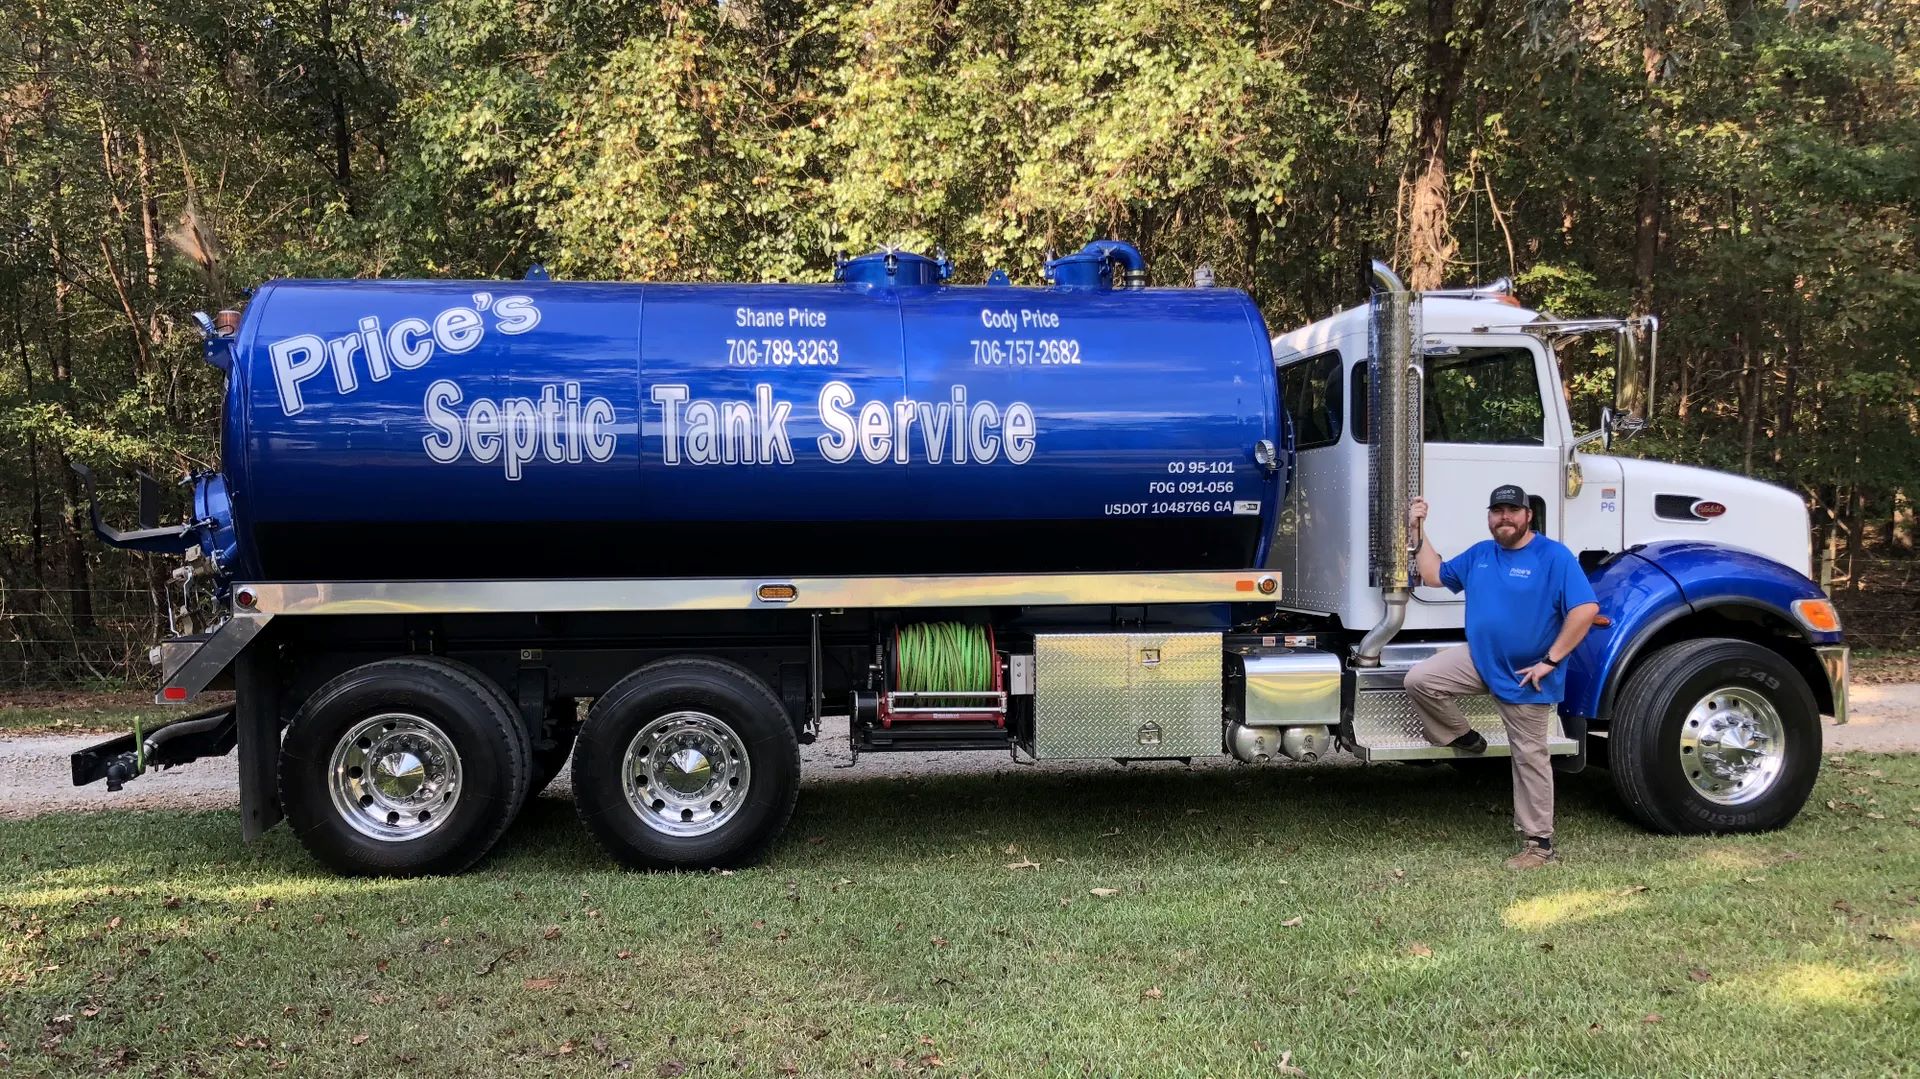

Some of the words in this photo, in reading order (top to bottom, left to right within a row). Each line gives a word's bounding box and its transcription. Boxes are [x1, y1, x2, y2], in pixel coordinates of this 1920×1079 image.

[735, 307, 785, 328] Shane
[788, 307, 827, 328] Price
[981, 308, 1018, 333] Cody
[1020, 308, 1060, 328] Price
[268, 292, 541, 416] Price's
[726, 339, 839, 366] 706-789-3263
[970, 339, 1082, 366] 706-757-2682
[422, 378, 616, 482] Septic
[651, 383, 795, 466] Tank
[816, 380, 1037, 466] Service
[1167, 461, 1186, 474] CO
[1188, 461, 1235, 474] 95-101
[1149, 481, 1176, 494] FOG
[1178, 481, 1234, 494] 091-056
[1104, 502, 1149, 515] USDOT
[1151, 501, 1211, 514] 1048766
[1213, 500, 1232, 512] GA
[1600, 501, 1616, 513] P6
[1735, 666, 1781, 690] 249
